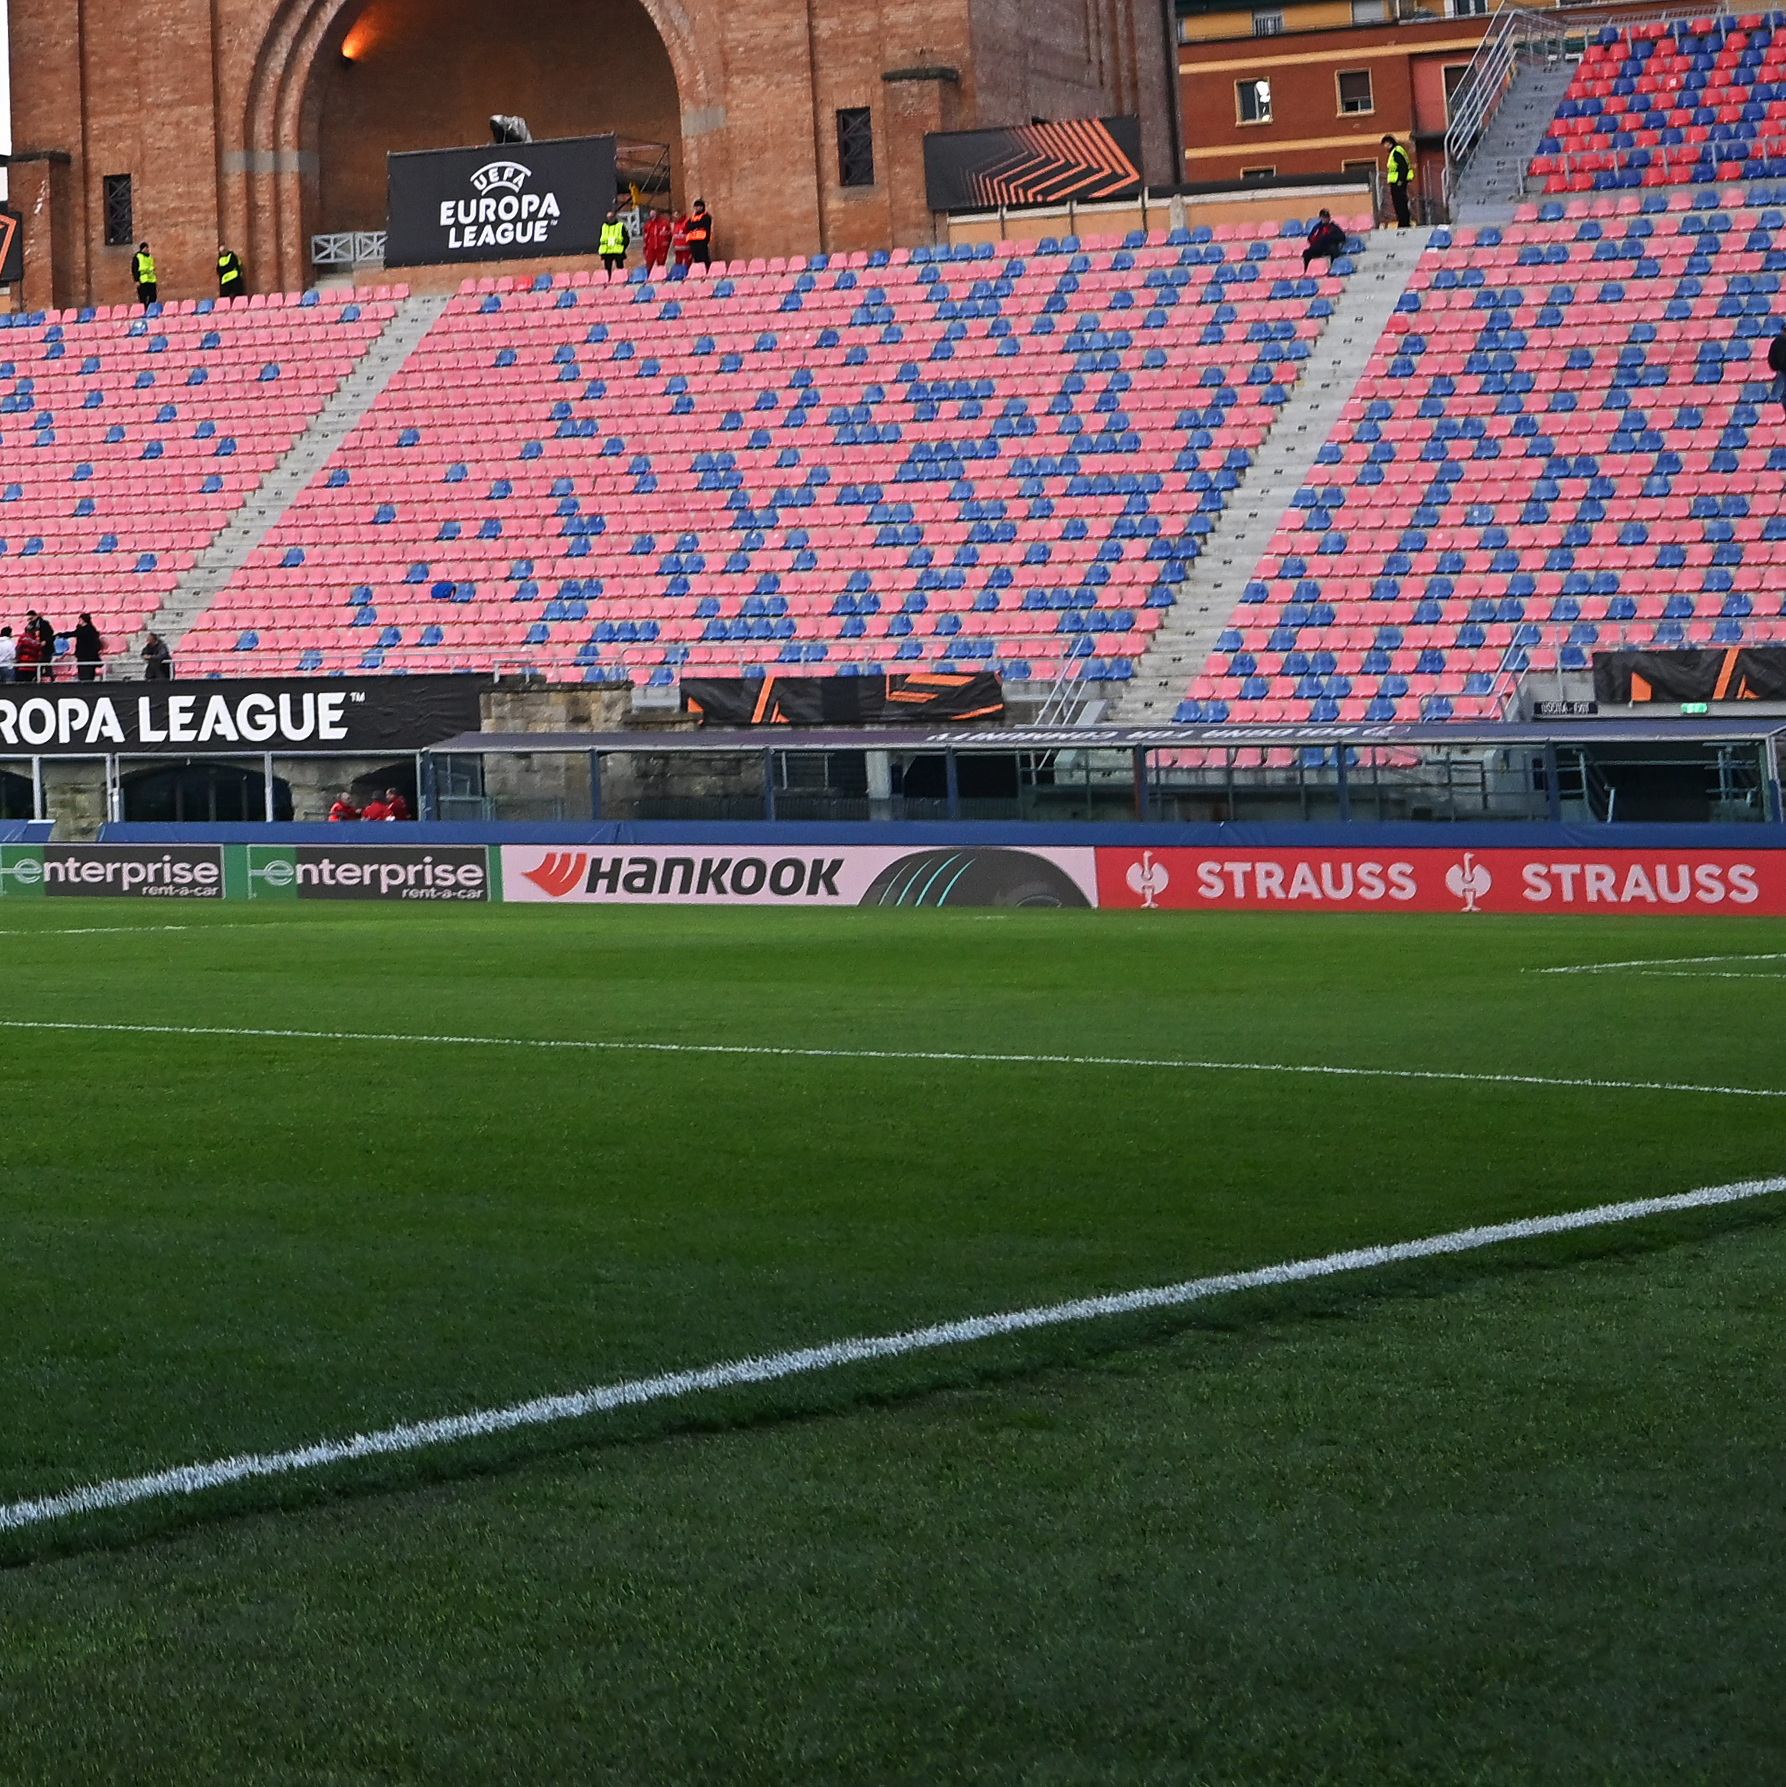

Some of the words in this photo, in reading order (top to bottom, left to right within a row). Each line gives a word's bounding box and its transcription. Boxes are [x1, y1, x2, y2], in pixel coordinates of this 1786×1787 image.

[473, 167, 526, 191] UEFA
[440, 192, 560, 226] EUROPA
[448, 219, 548, 249] LEAGUE
[138, 692, 349, 744] LEAGUE
[14, 854, 220, 889] enterprise
[264, 856, 484, 893] enterprise
[1196, 860, 1417, 901] STRAUSS
[1521, 862, 1759, 904] STRAUSS
[141, 882, 220, 897] rent-a-car
[401, 885, 484, 901] rent-a-car
